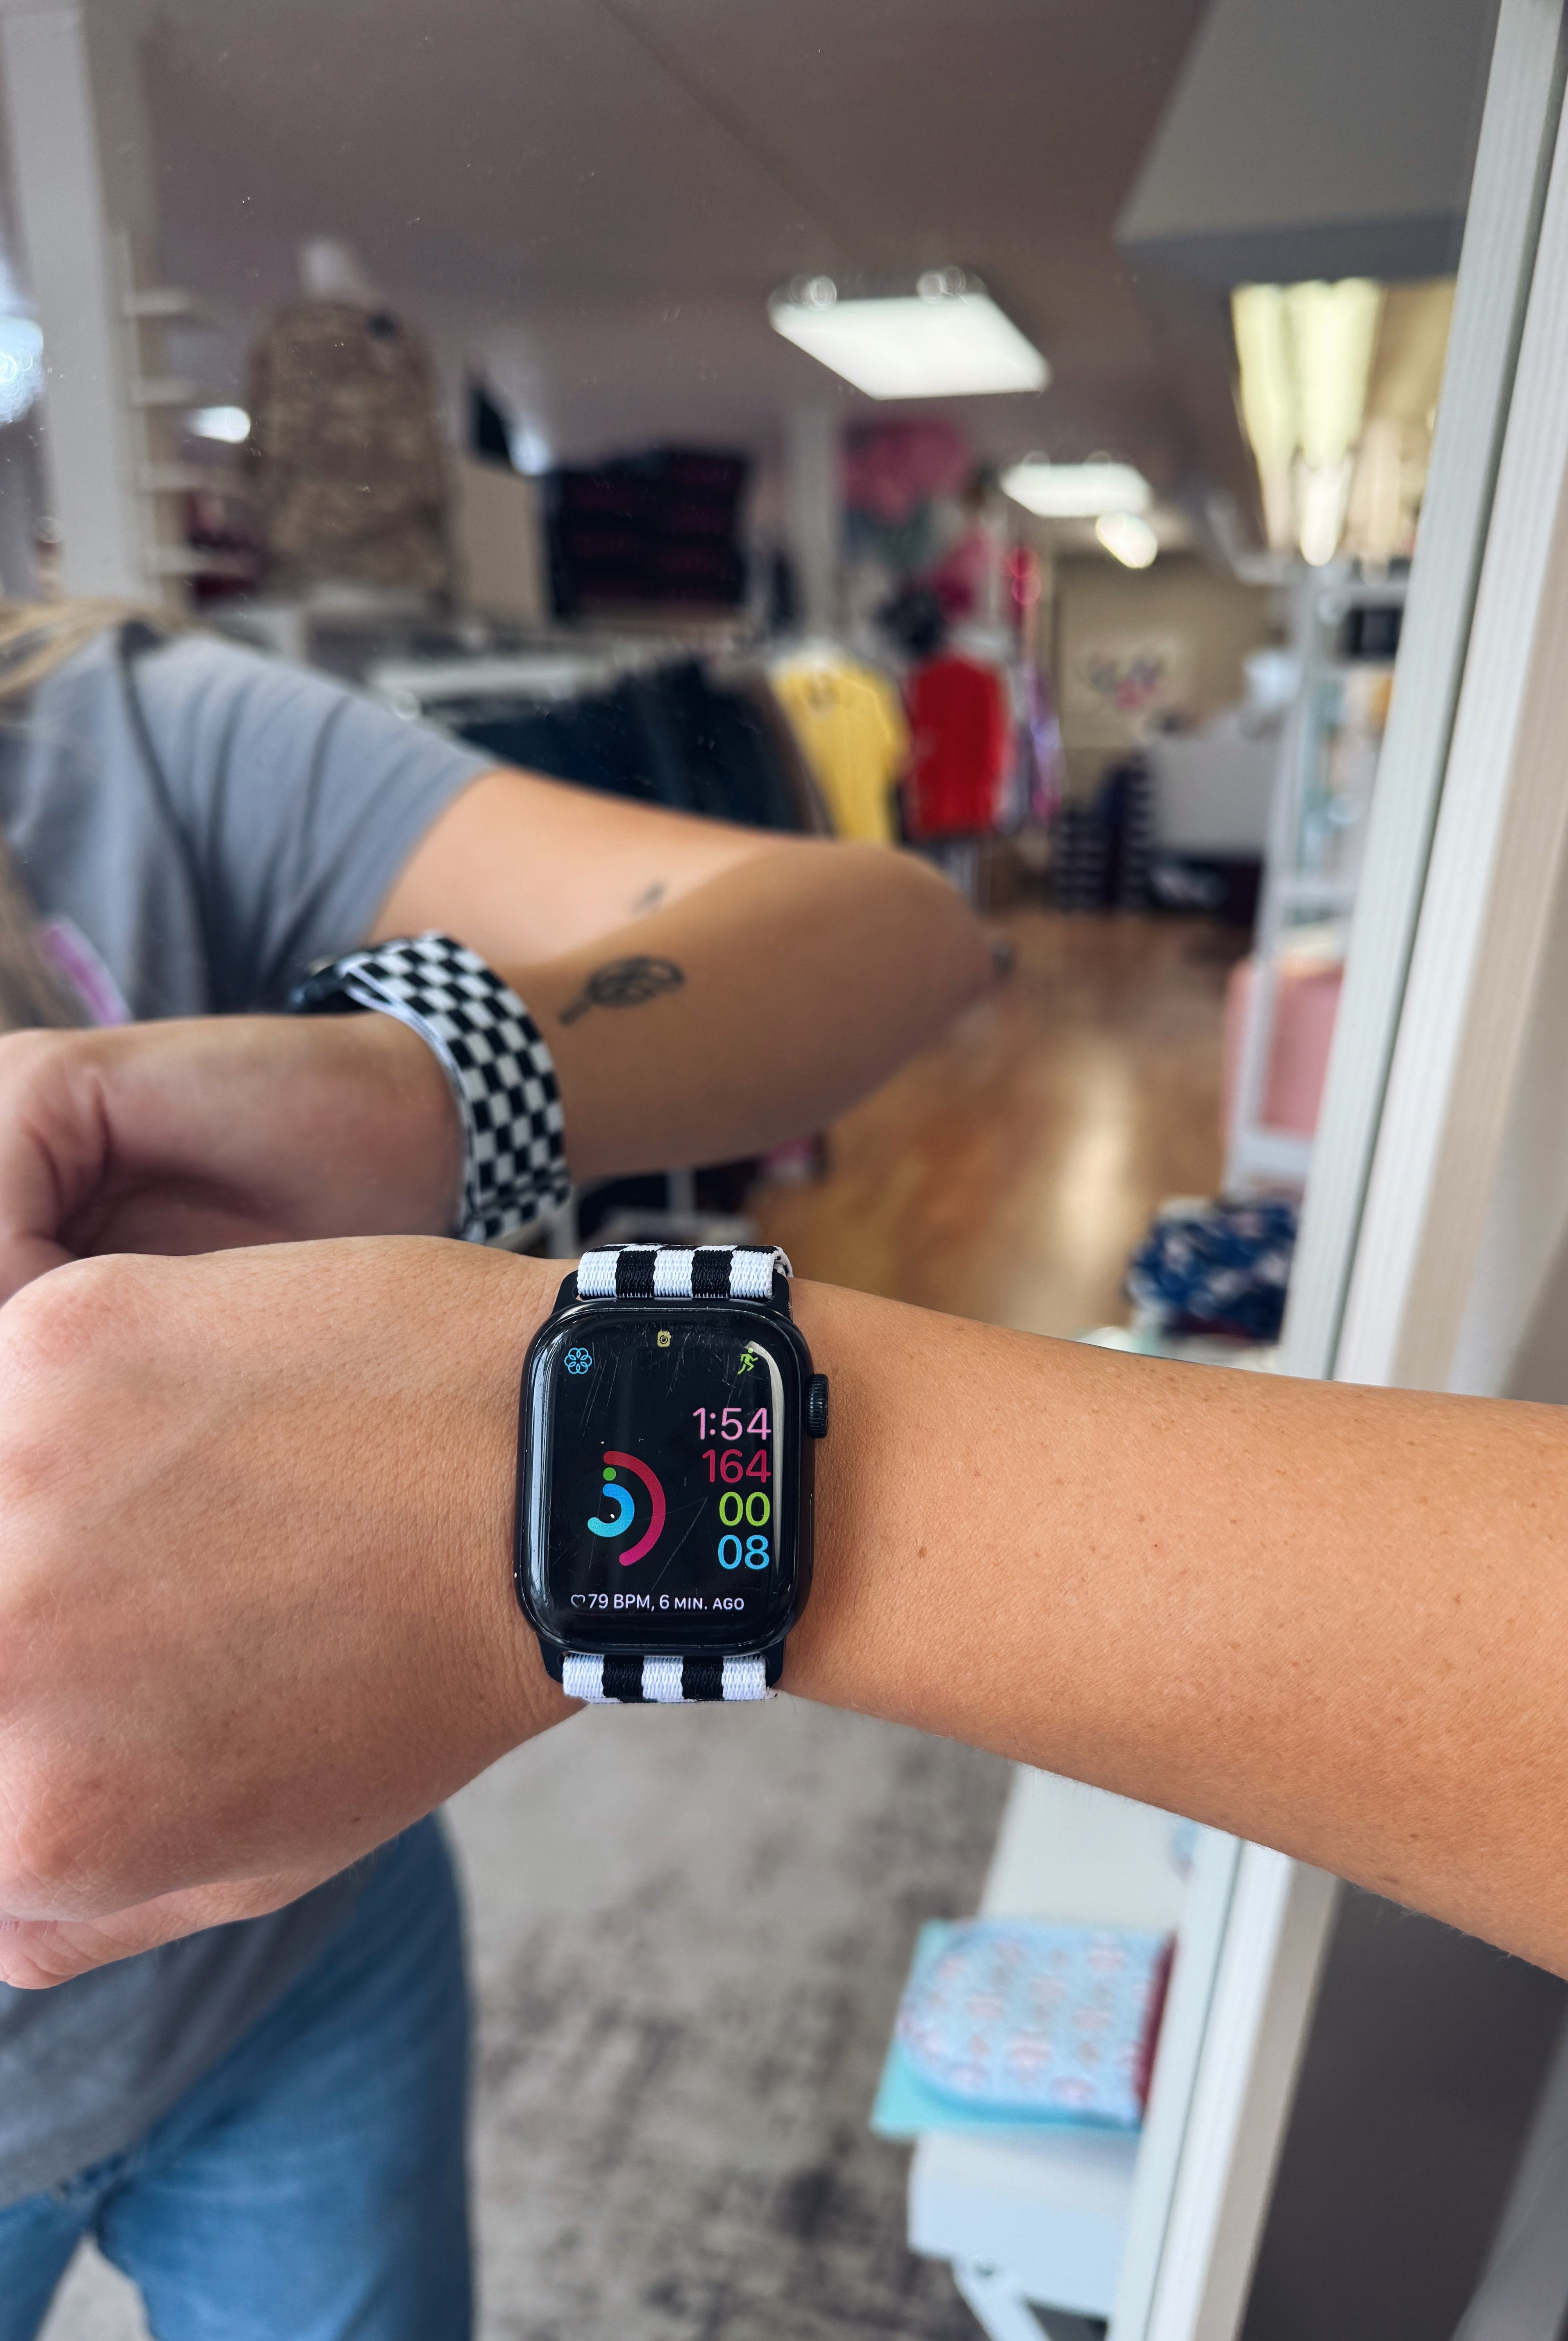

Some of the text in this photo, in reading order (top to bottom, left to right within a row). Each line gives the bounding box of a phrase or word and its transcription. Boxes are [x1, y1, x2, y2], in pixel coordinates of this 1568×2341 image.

[693, 1407, 772, 1440] 1:54
[702, 1449, 771, 1483] 164
[719, 1491, 770, 1526] 00
[718, 1534, 770, 1570] 08
[588, 1593, 744, 1611] 79 BPM, 6 MIN. AGO
